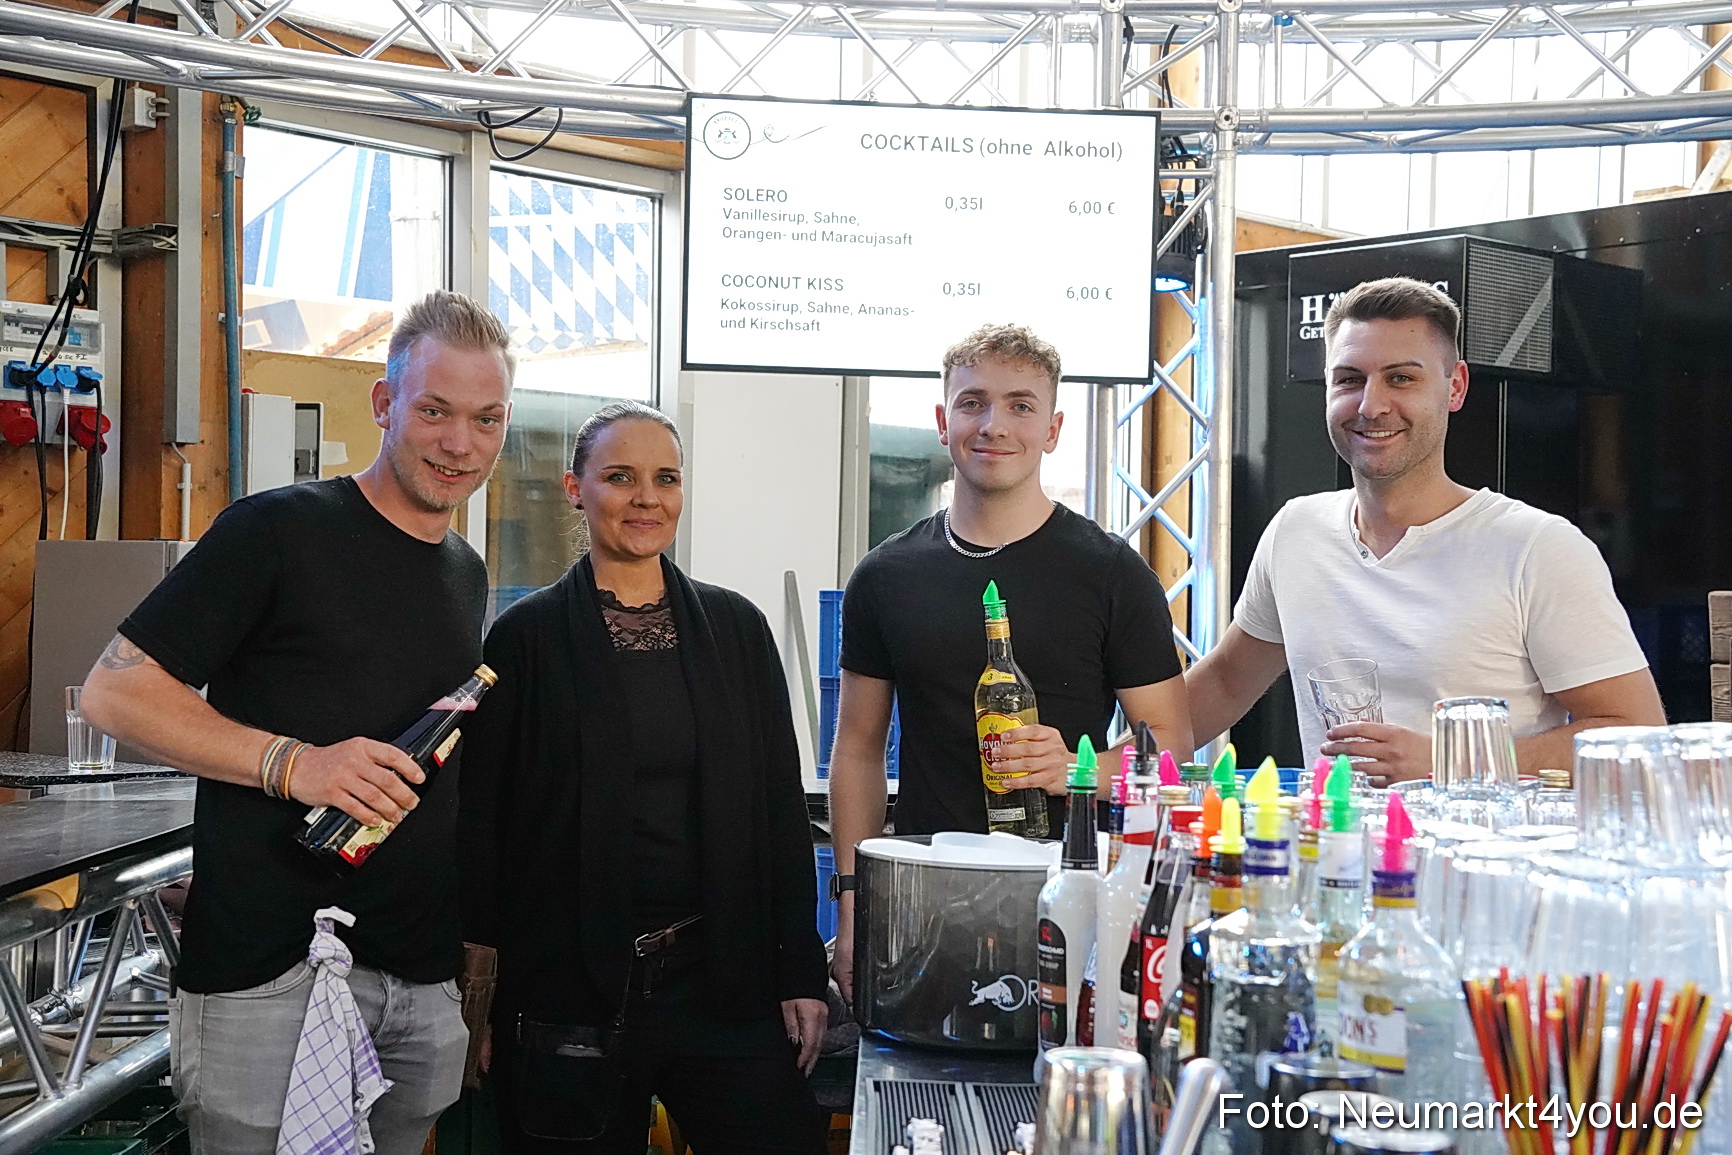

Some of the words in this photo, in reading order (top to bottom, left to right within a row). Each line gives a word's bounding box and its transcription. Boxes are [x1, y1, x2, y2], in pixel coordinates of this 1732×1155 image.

[860, 133, 974, 154] COCKTAILS
[979, 137, 1033, 158] (ohne
[1043, 140, 1123, 163] Alkohol)
[723, 187, 788, 203] SOLERO
[722, 207, 809, 225] Vanillesirup,
[813, 211, 860, 227] Sahne,
[1068, 200, 1102, 216] 6,00
[1106, 201, 1116, 215] €
[722, 226, 788, 243] Orangen-
[791, 229, 817, 243] und
[821, 230, 913, 247] Maracujasaft
[721, 273, 802, 290] COCONUT
[807, 277, 844, 292] KISS
[1066, 286, 1100, 302] 6,00
[1105, 287, 1113, 301] €
[720, 298, 802, 315] Kokossirup,
[807, 302, 854, 316] Sahne,
[857, 303, 915, 317] Ananas-
[720, 316, 746, 329] und
[750, 317, 821, 332] Kirschsaft
